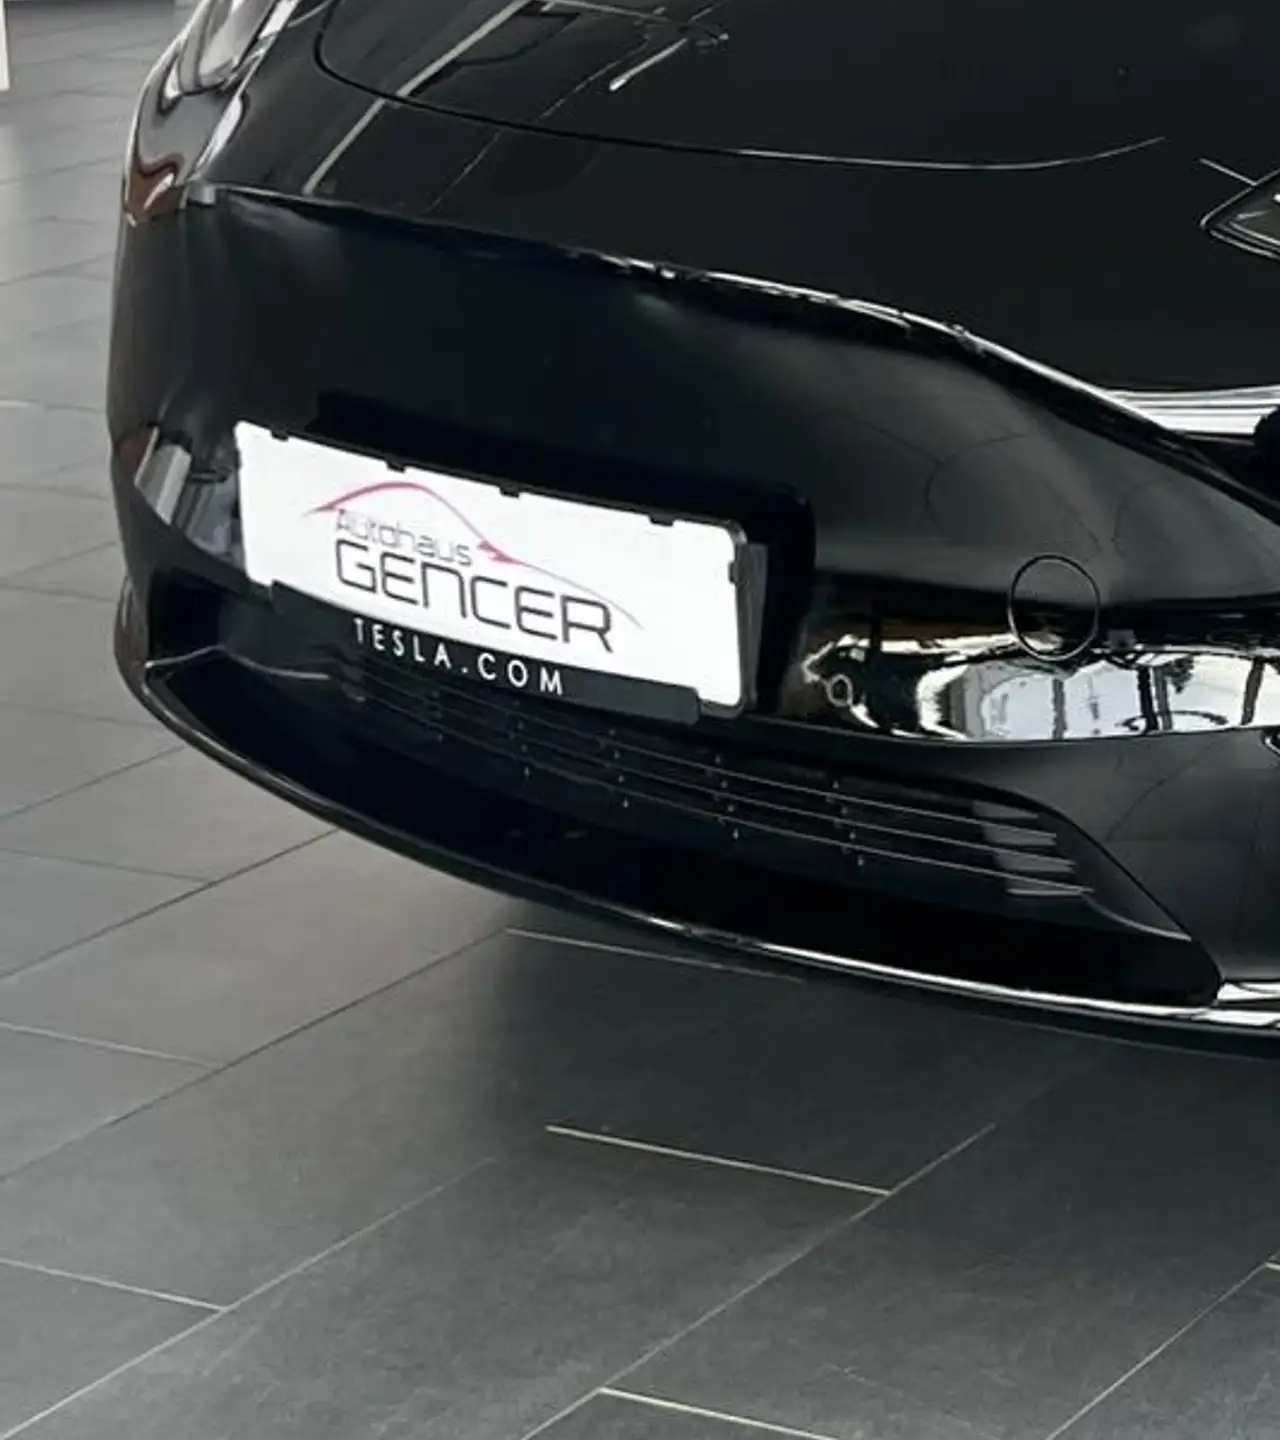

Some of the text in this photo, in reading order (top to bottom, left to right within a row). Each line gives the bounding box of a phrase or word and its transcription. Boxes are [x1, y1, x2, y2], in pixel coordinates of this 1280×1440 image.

[336, 509, 474, 566] Autohaus
[335, 539, 613, 654] GENCER
[353, 618, 565, 695] TESLA.COM
